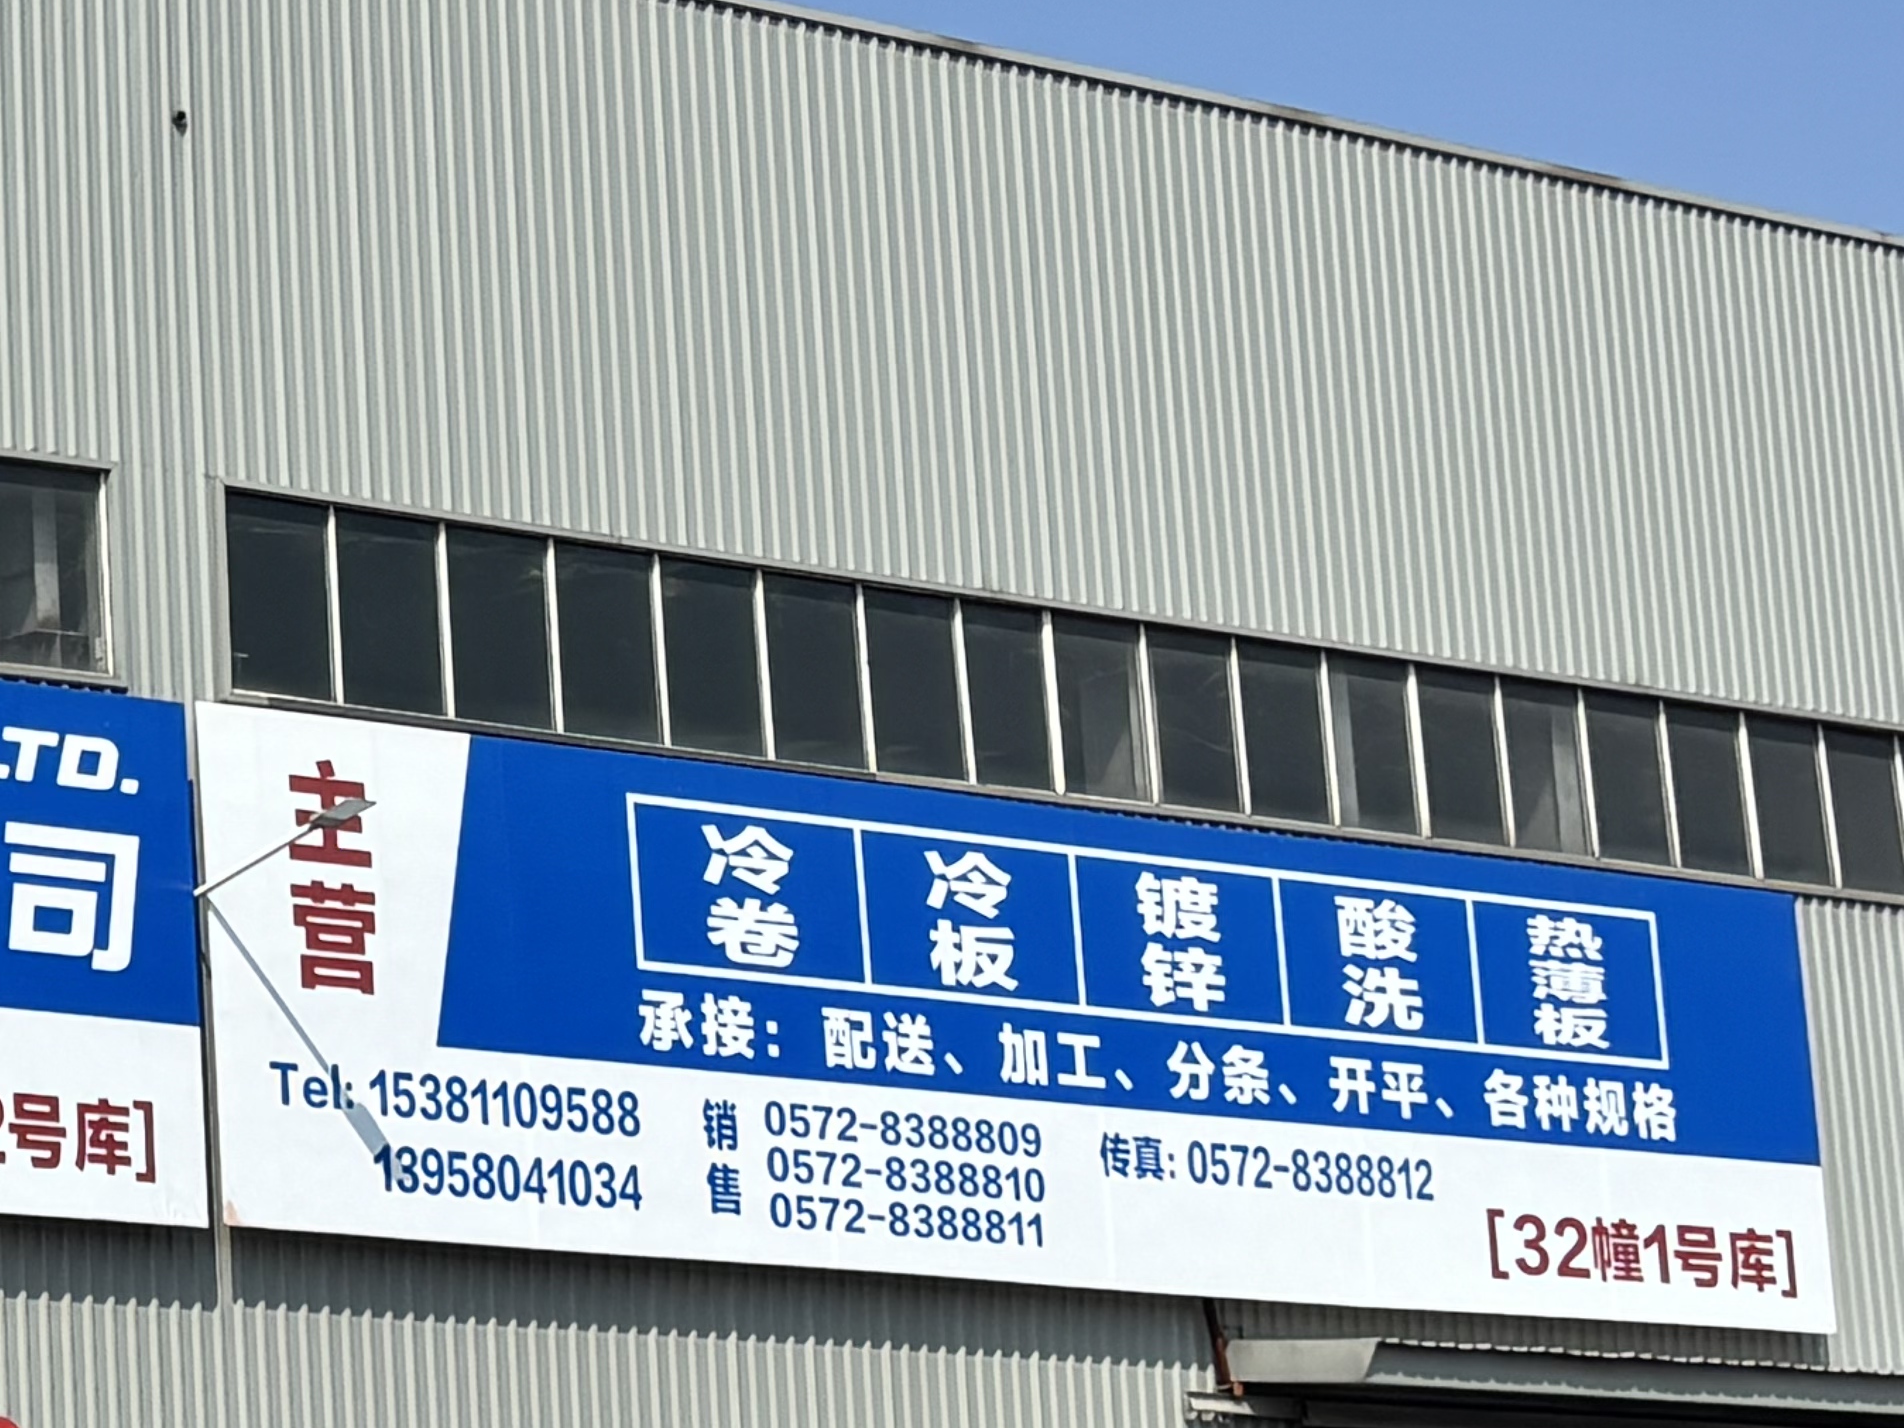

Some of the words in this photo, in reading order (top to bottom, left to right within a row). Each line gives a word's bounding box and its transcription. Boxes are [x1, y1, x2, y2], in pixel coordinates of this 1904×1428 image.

[289, 760, 376, 995] 主营
[702, 824, 799, 969] 冷卷
[926, 851, 1019, 992] 冷板
[1135, 872, 1226, 1012] 镀锌
[1335, 896, 1423, 1032] 酸洗
[1526, 913, 1610, 1051] 热薄板
[270, 1061, 355, 1109] Tel:
[370, 1070, 640, 1137] 15381109588
[765, 1101, 1042, 1158] 0572-8388809
[374, 1143, 642, 1211] 13958041034
[703, 1098, 742, 1216] 销售
[768, 1147, 1045, 1203] 0572-8388810
[1188, 1141, 1434, 1201] 0572-8388812
[770, 1194, 1044, 1247] 0572-8388811
[1489, 1209, 1794, 1292] [32幢1号库]
